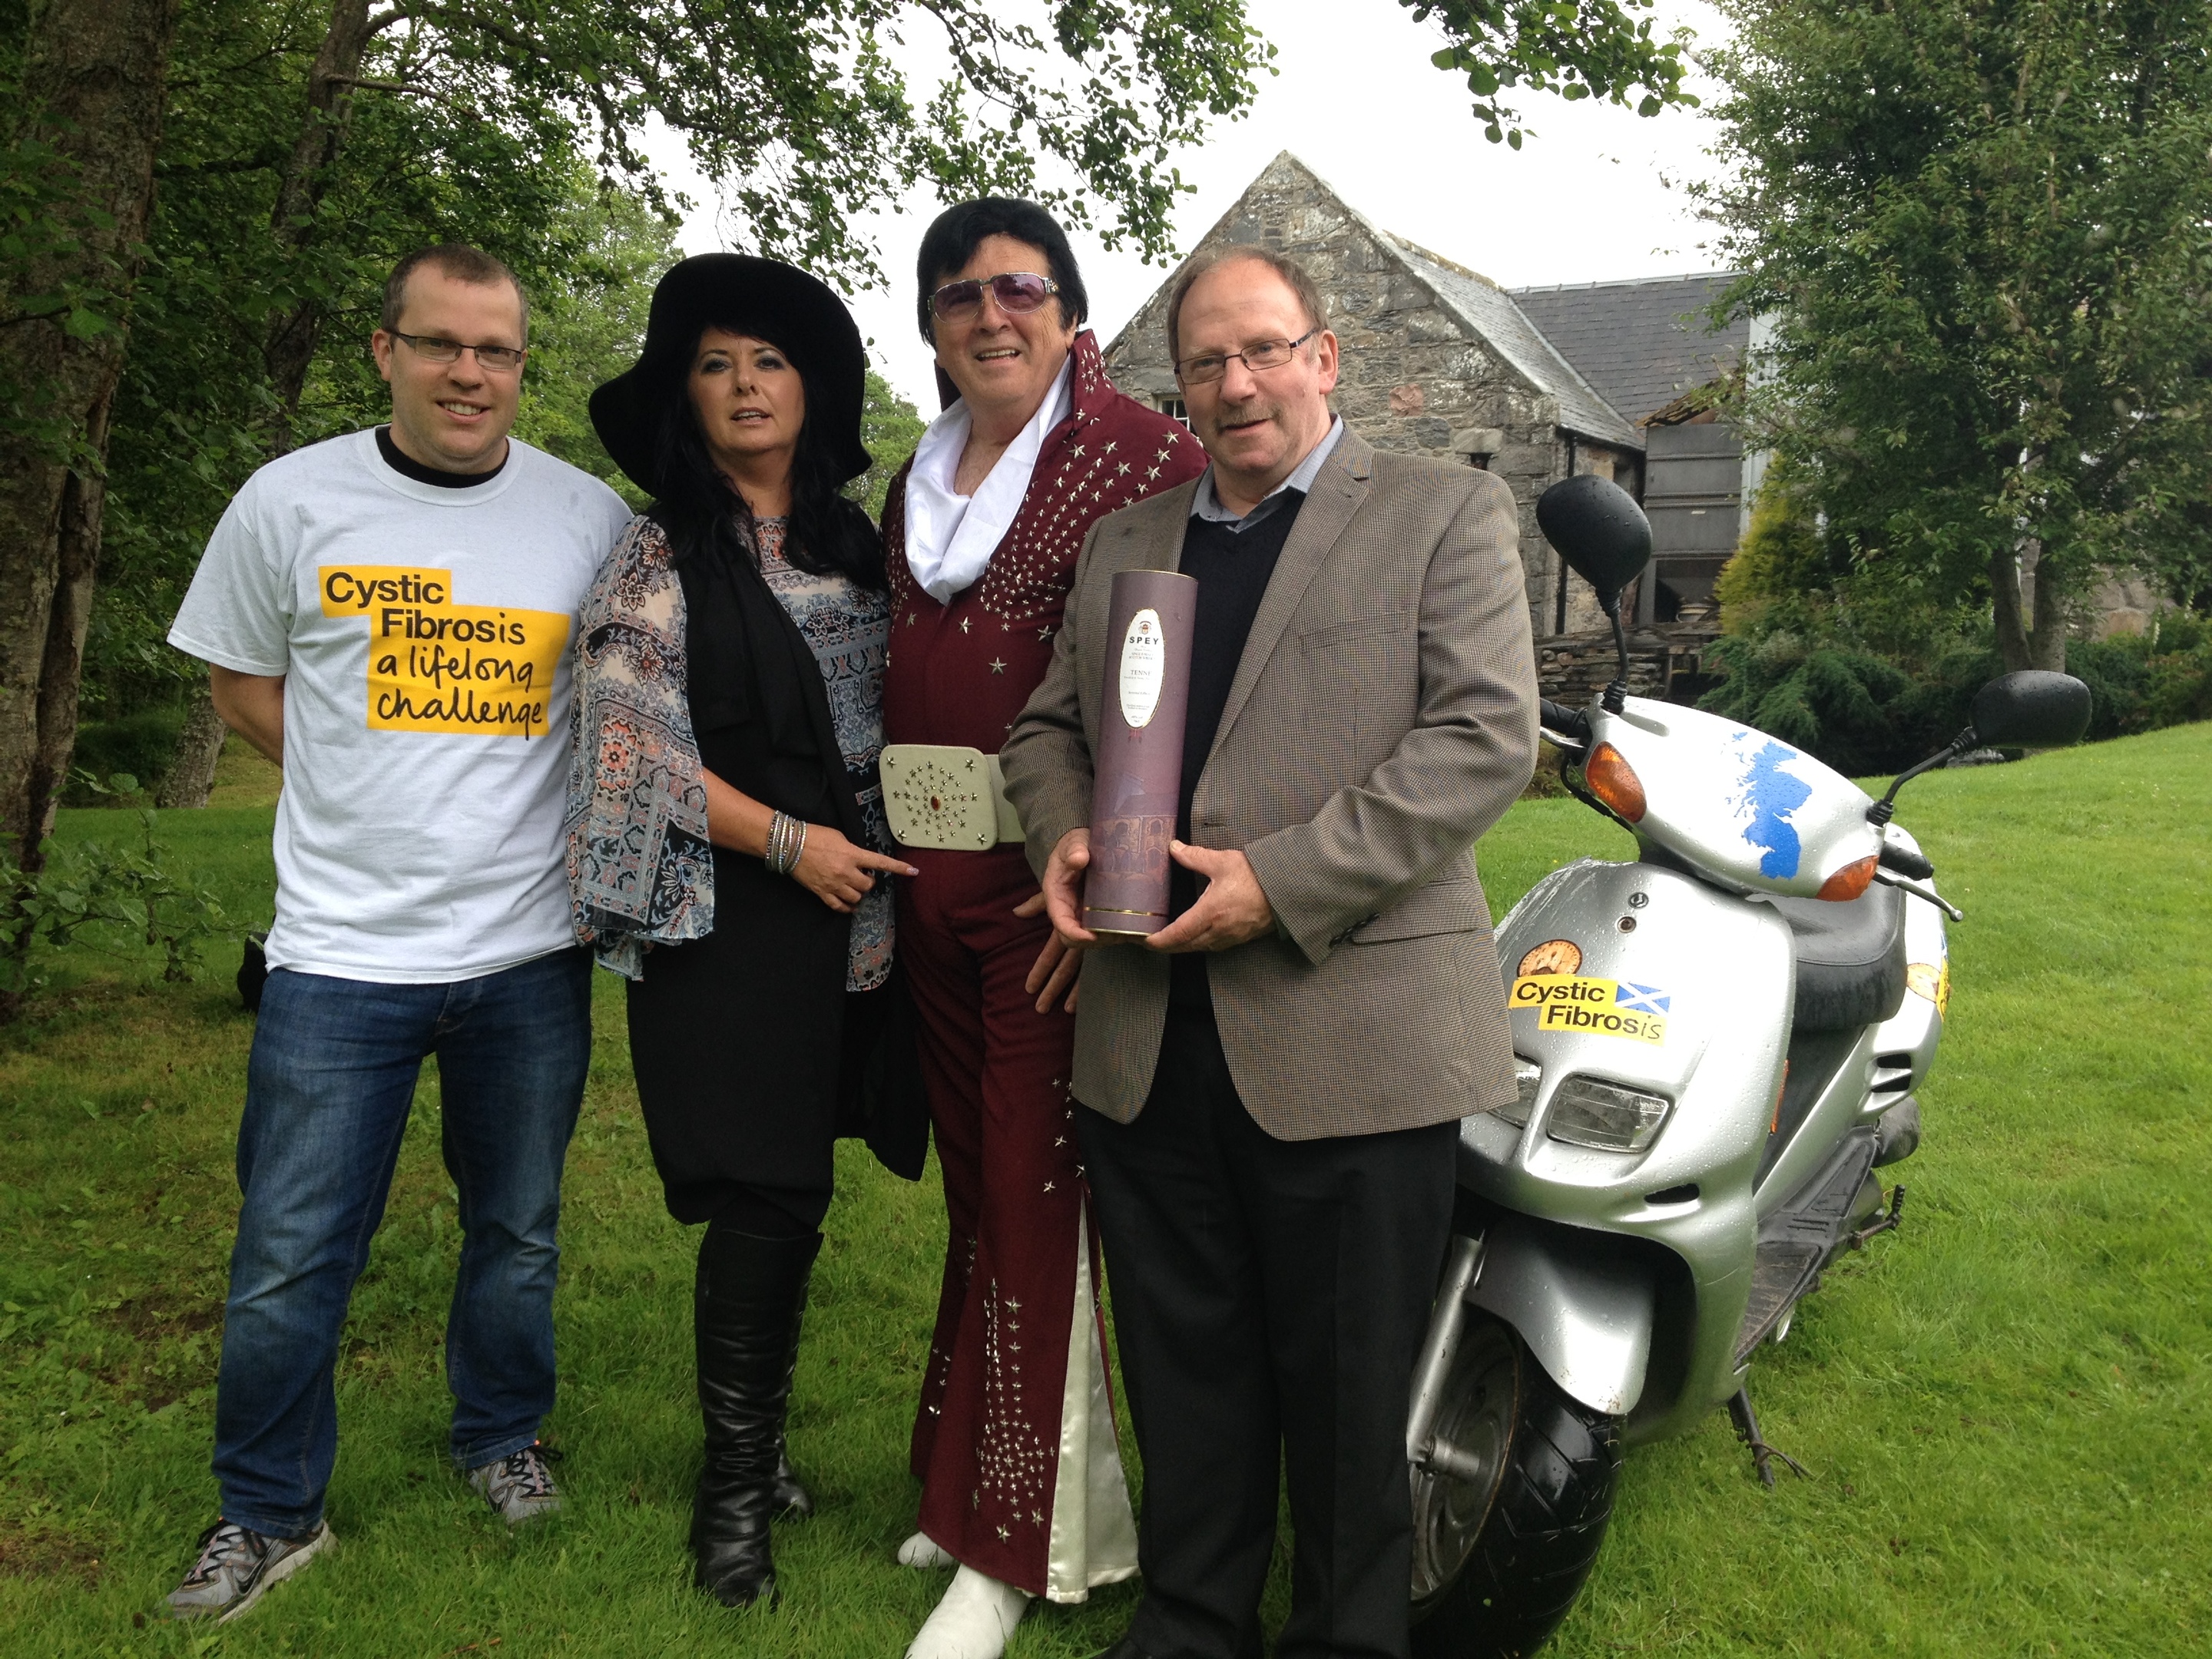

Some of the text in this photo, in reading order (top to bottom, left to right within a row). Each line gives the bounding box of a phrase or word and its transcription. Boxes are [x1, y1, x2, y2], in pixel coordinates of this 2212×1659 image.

[326, 571, 444, 608] Cystic
[382, 608, 525, 645] Fibrosis
[1129, 635, 1160, 645] SPEY
[376, 644, 533, 692] a lifelong
[377, 686, 542, 740] challenge
[1516, 982, 1605, 1004] Cystic
[1547, 1004, 1662, 1039] Fibrosis
